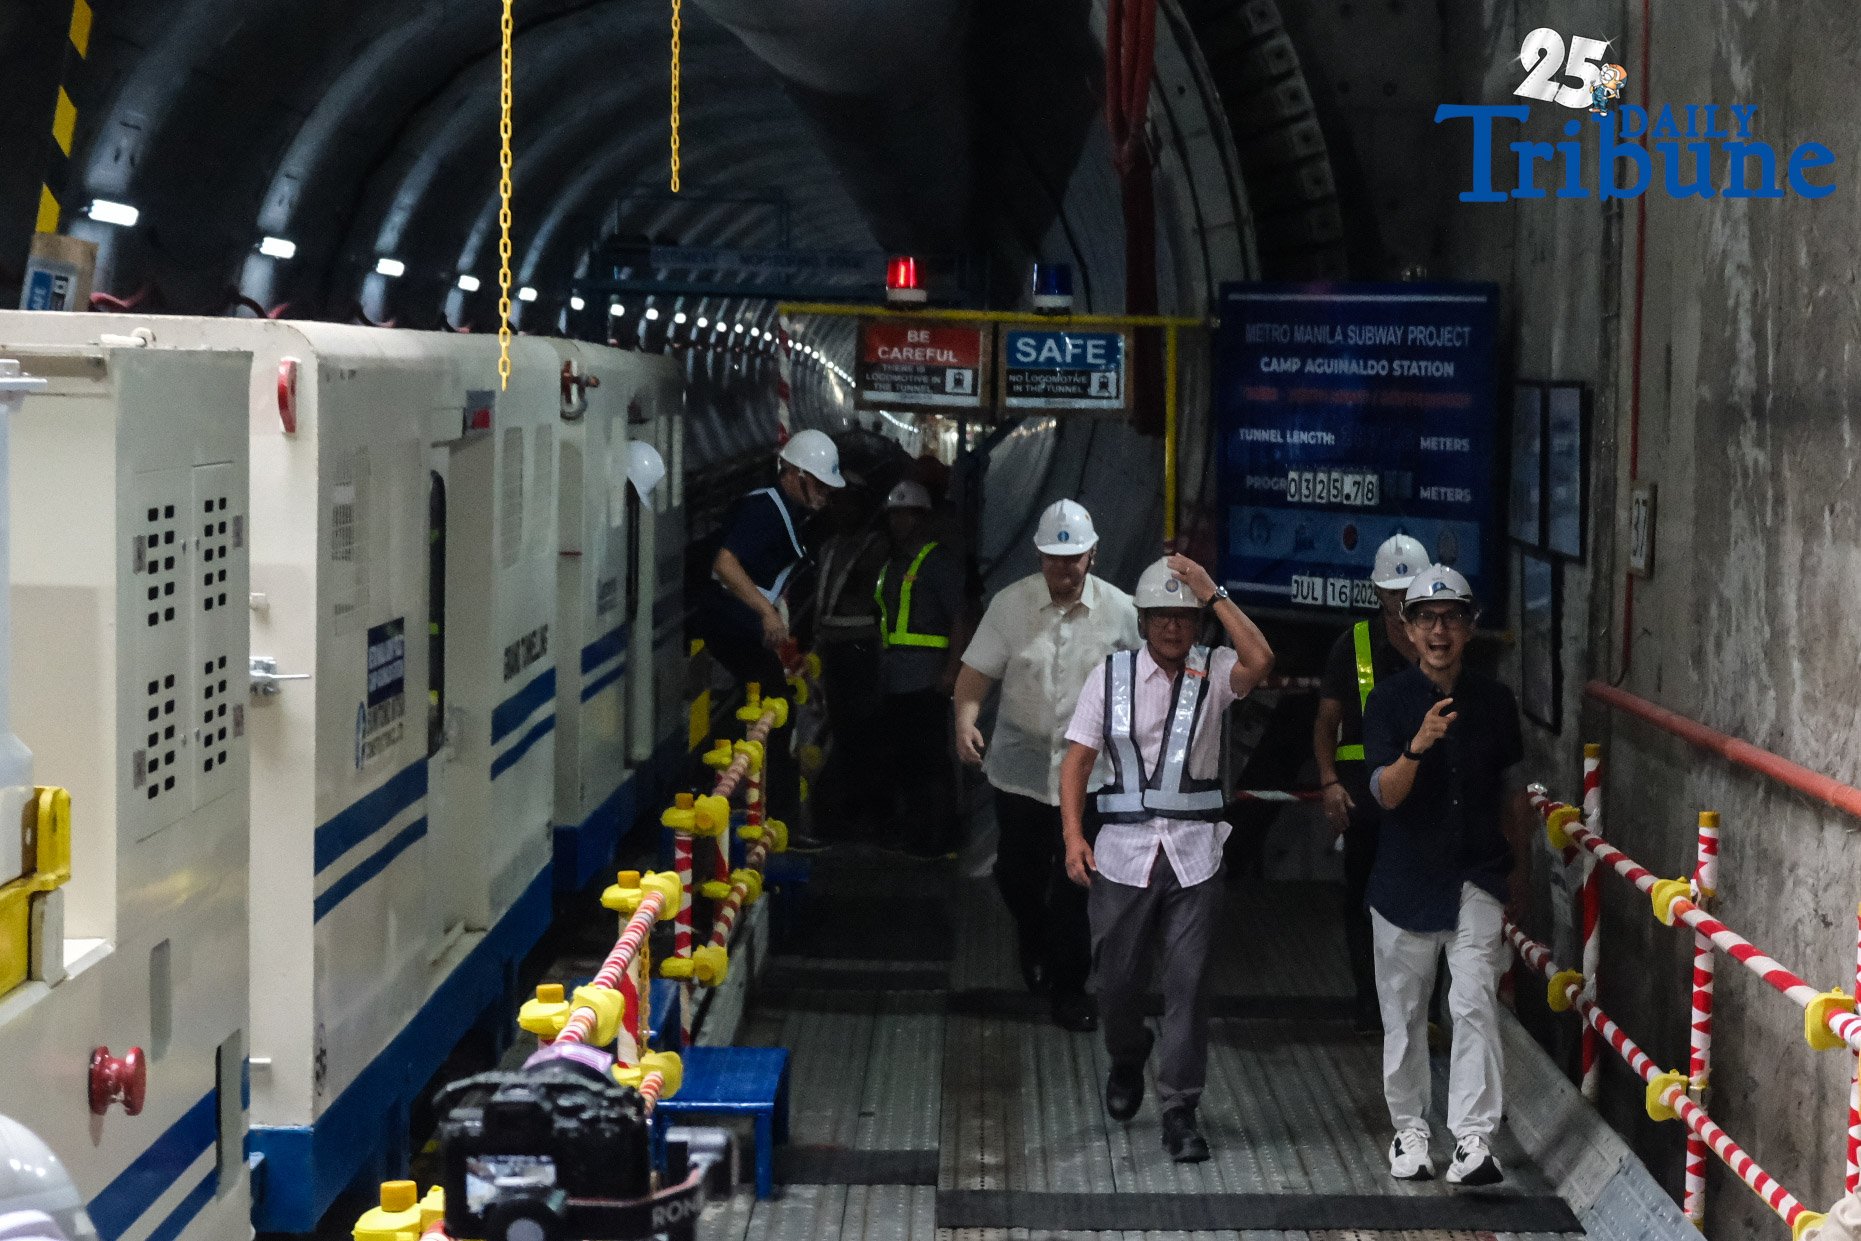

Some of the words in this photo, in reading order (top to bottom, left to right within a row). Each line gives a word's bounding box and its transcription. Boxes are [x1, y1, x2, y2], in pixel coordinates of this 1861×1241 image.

[907, 330, 930, 343] BE
[1245, 323, 1290, 344] METRO
[1294, 324, 1343, 345] MANILA
[1348, 325, 1403, 346] SUBWAY
[1408, 326, 1471, 347] PROJECT
[878, 346, 958, 362] CAREFUL
[1016, 337, 1106, 364] SAFE
[1260, 356, 1301, 373] CAMP
[1304, 358, 1389, 376] AGUINALDO
[1392, 360, 1455, 377] STATION
[1009, 374, 1023, 382] NO
[1238, 428, 1283, 443] TUNNEL
[1420, 436, 1470, 451] METERS
[1419, 487, 1471, 502] METERS
[1293, 579, 1319, 601] JUL
[1330, 582, 1348, 603] 16
